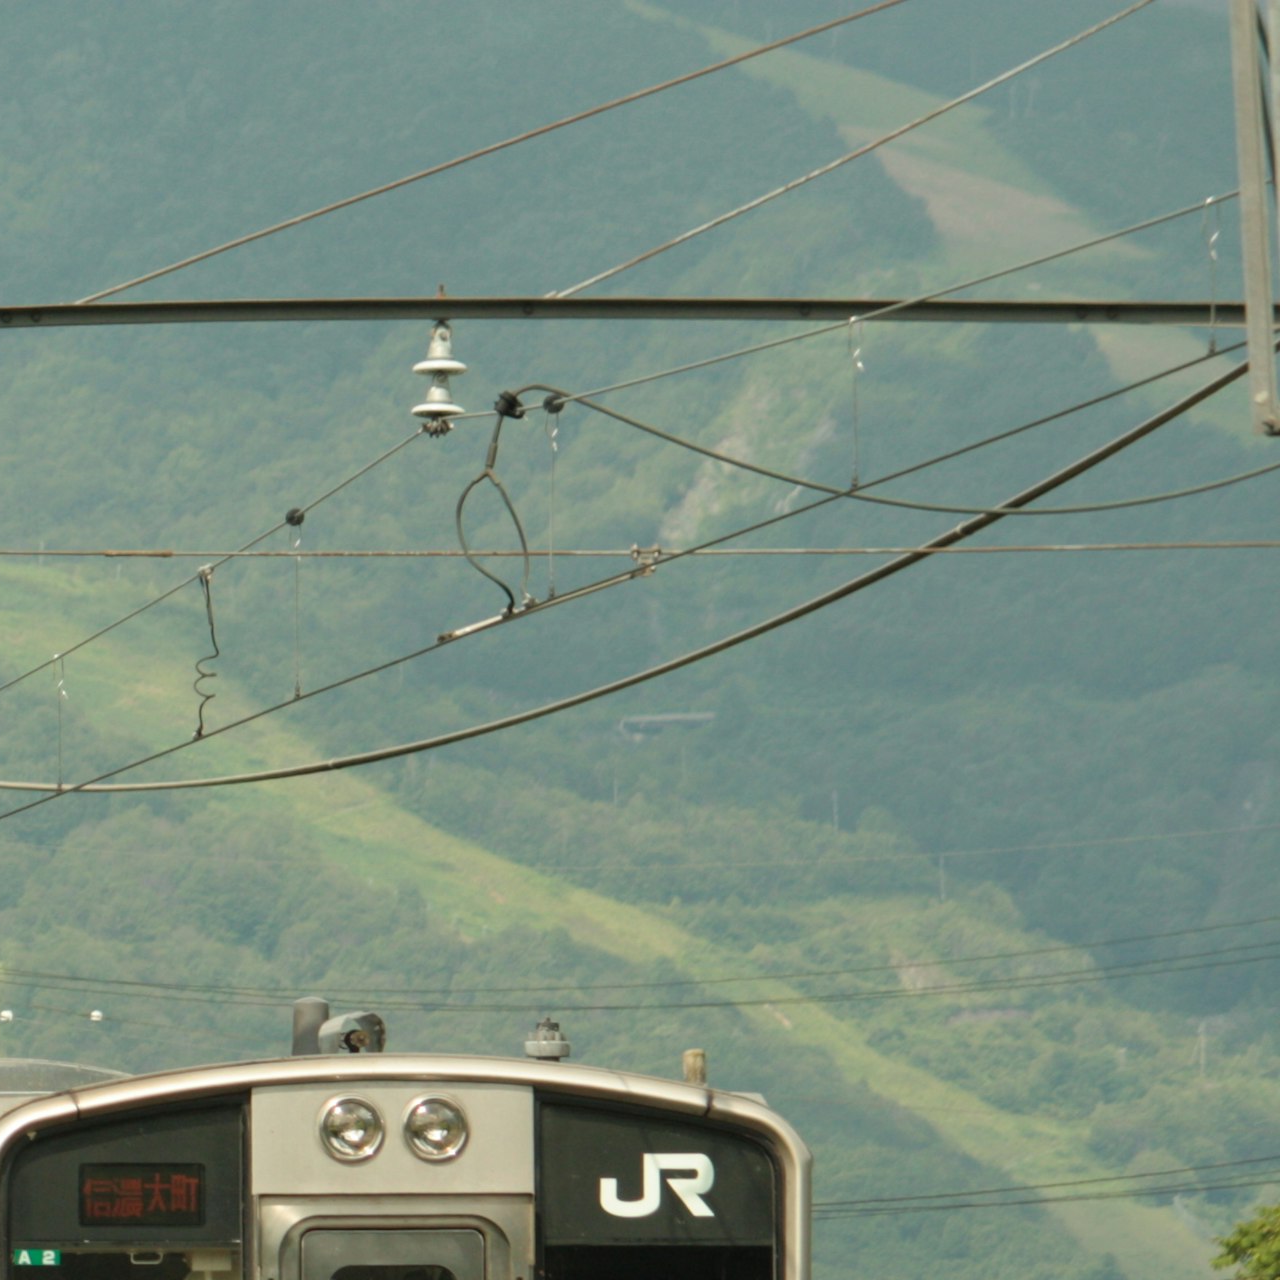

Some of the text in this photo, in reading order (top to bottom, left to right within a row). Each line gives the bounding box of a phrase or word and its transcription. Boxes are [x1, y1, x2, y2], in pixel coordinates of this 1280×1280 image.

[82, 1172, 200, 1218] 信濃大町
[600, 1153, 715, 1217] JR
